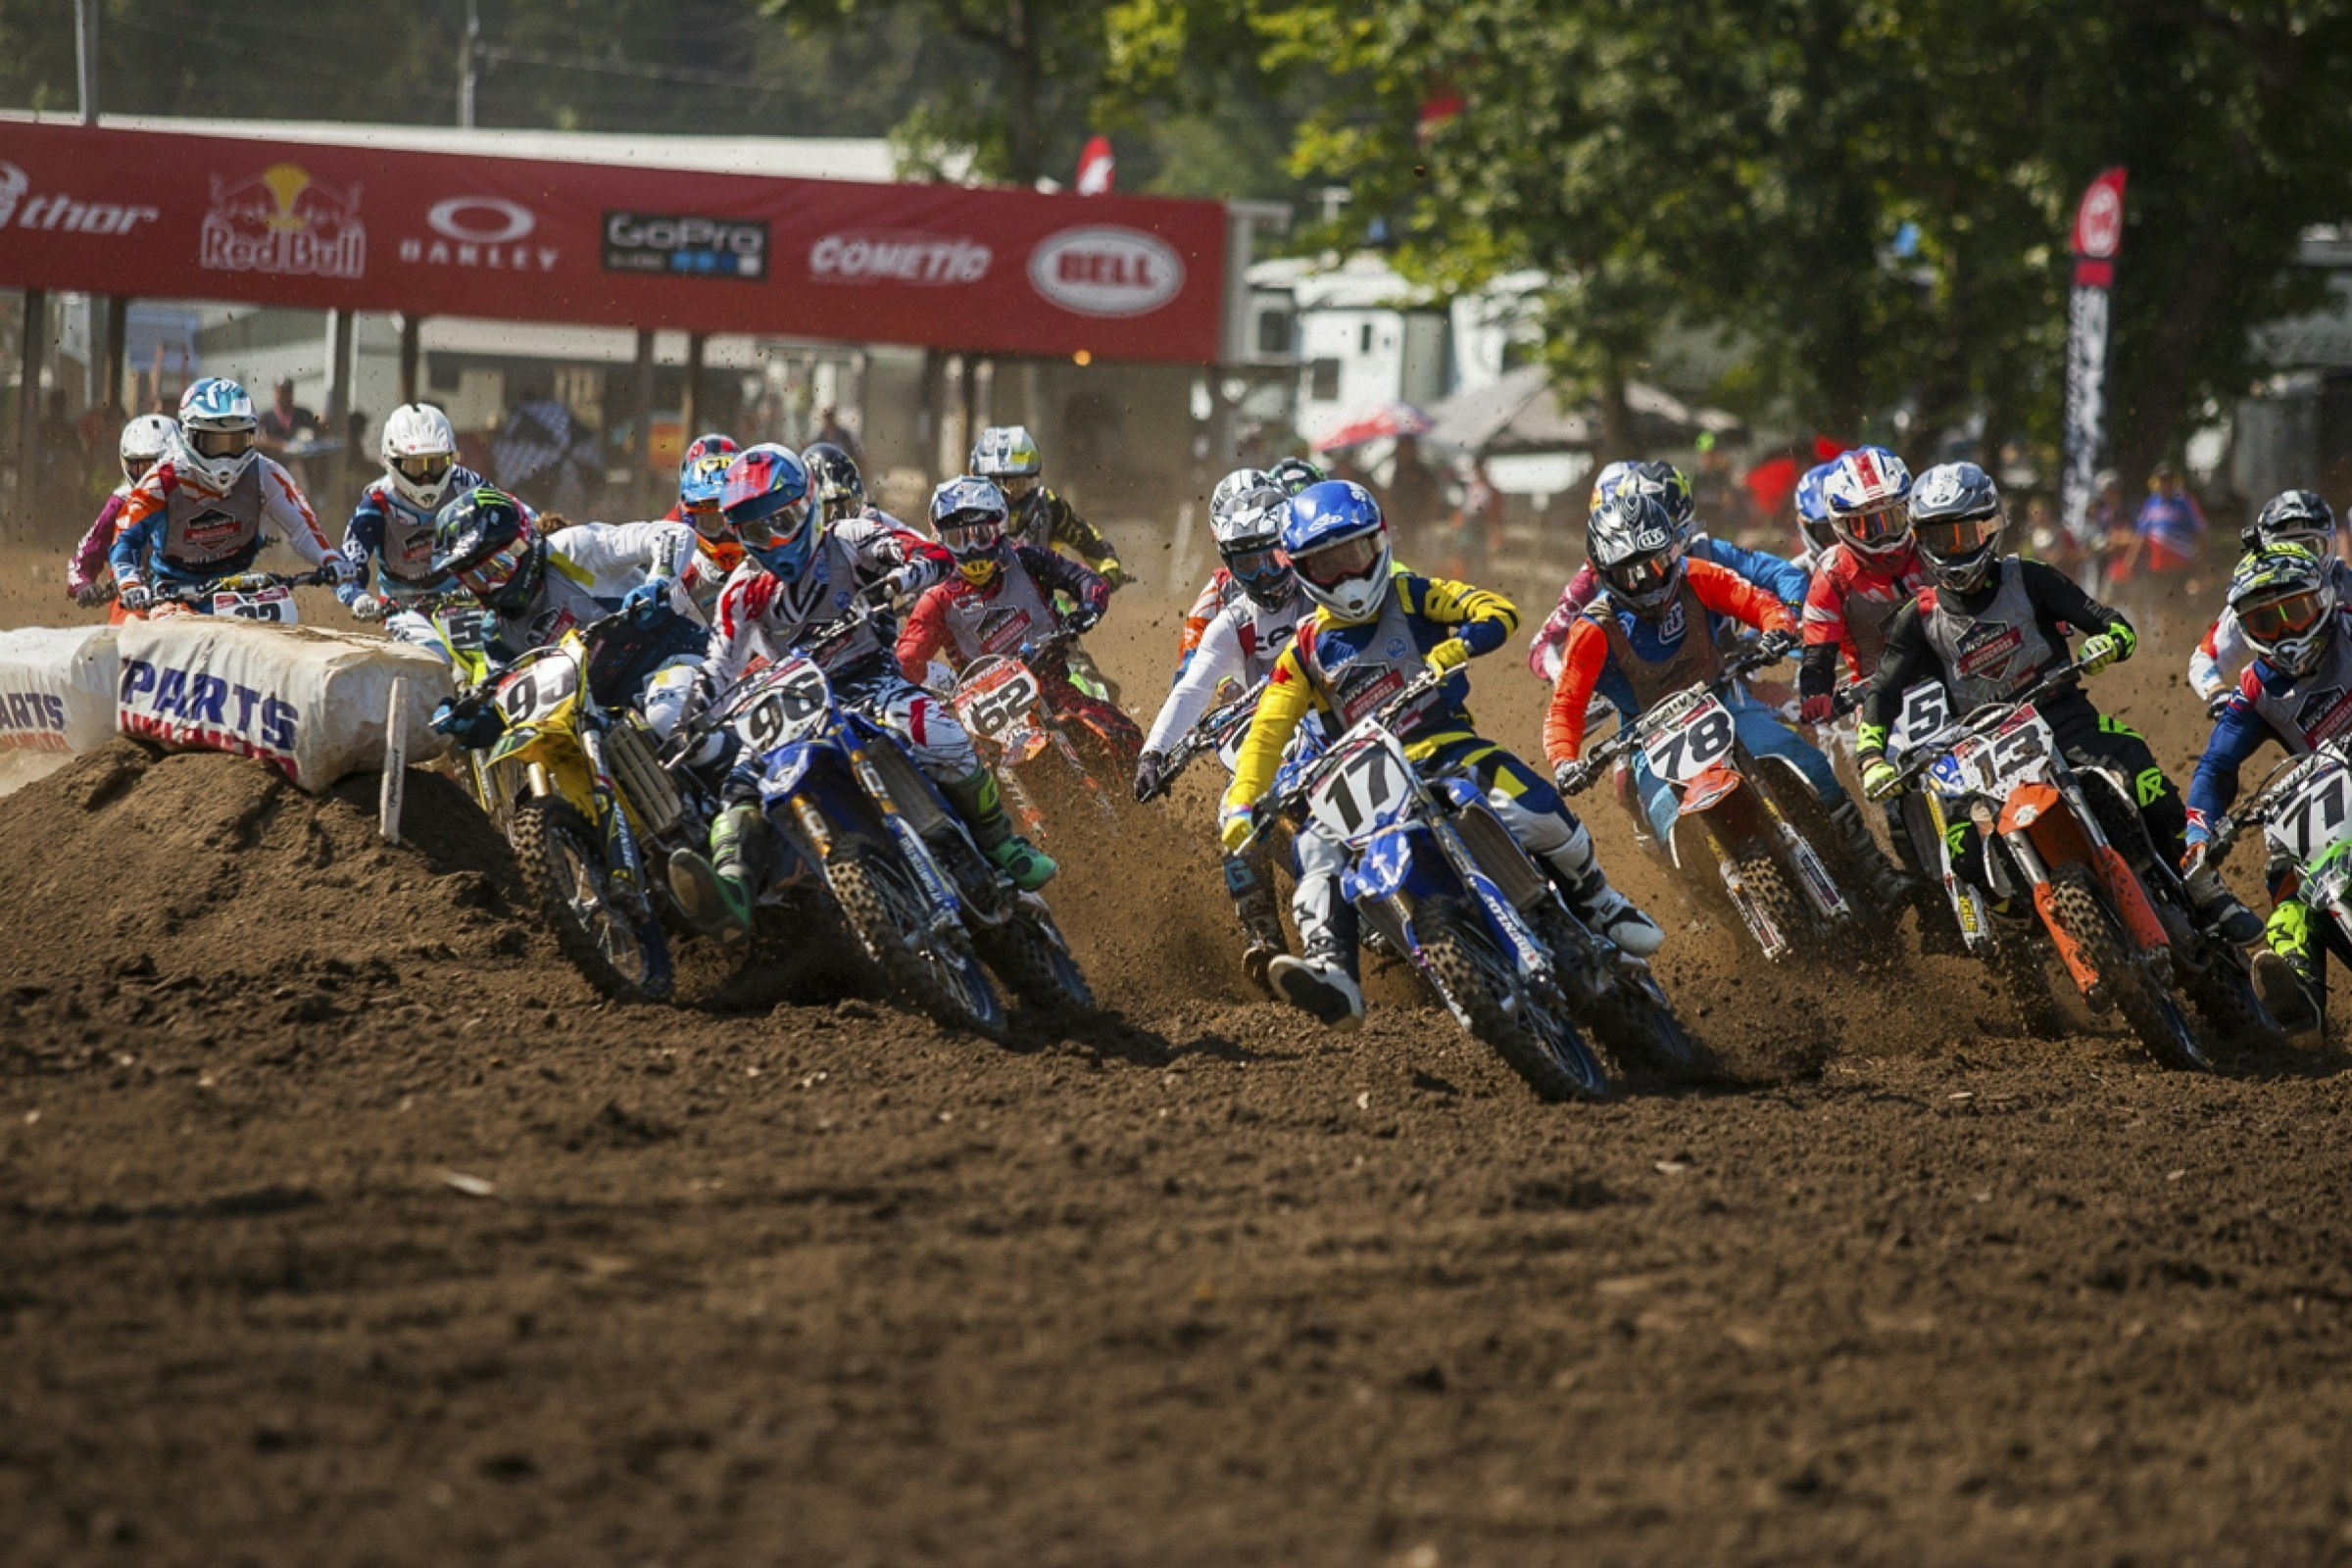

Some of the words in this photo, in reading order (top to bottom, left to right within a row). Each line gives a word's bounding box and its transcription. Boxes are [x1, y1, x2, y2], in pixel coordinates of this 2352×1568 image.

[20, 195, 159, 235] thor
[609, 214, 764, 254] GoPro
[399, 239, 559, 272] OAKLEY
[1058, 250, 1154, 290] BELL
[120, 659, 299, 751] PARTS
[969, 677, 1032, 735] 62
[1909, 686, 1942, 743] 5
[1651, 710, 1733, 780] 78
[1974, 724, 2044, 791] 13
[1324, 742, 1390, 833] 17
